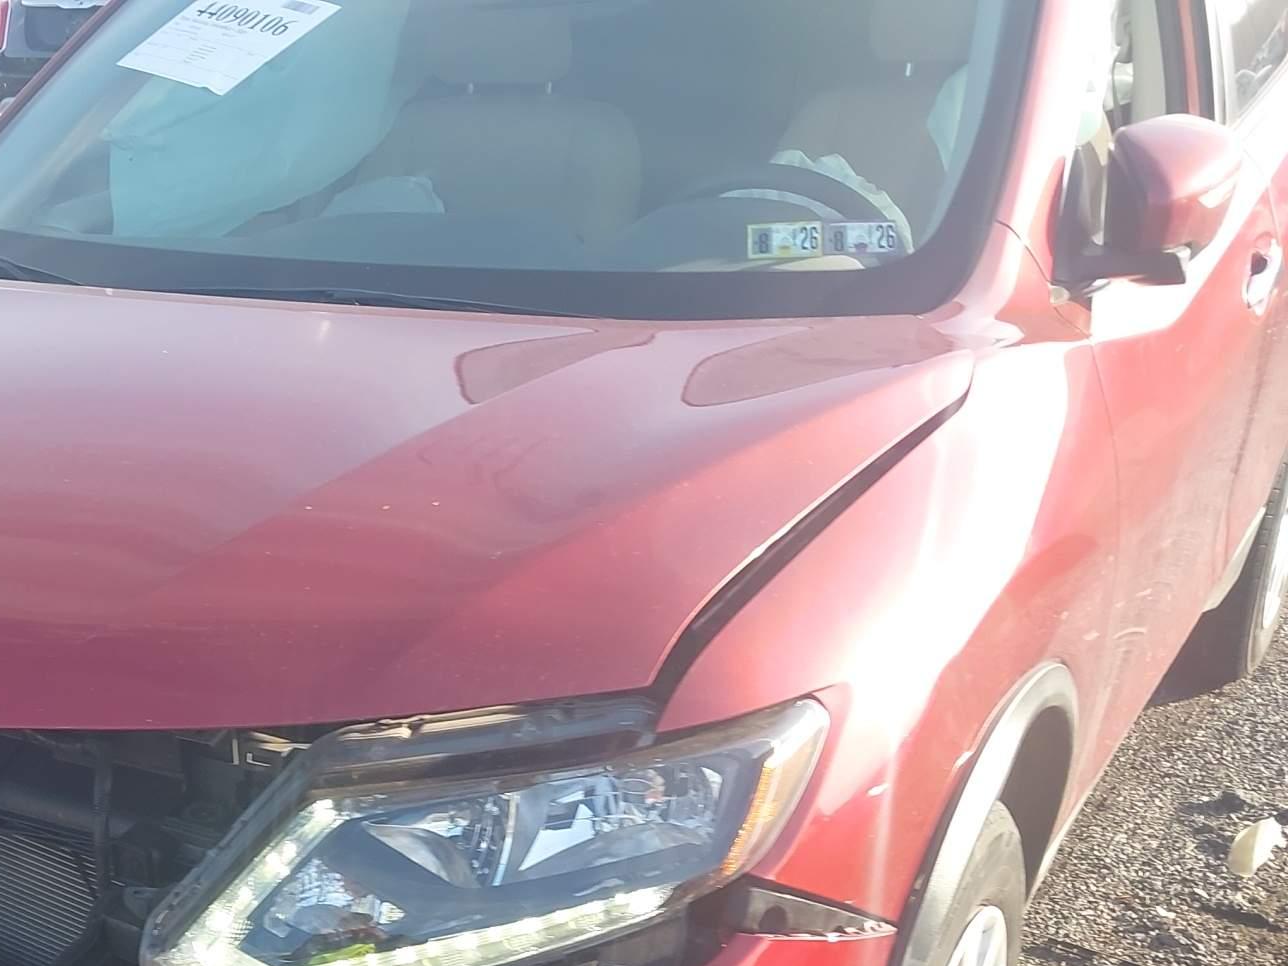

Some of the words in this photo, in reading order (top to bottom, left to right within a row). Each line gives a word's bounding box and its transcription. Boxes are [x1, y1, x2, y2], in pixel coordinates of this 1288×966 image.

[196, 1, 299, 36] 44090106
[799, 226, 819, 250] 26
[875, 224, 896, 249] 26
